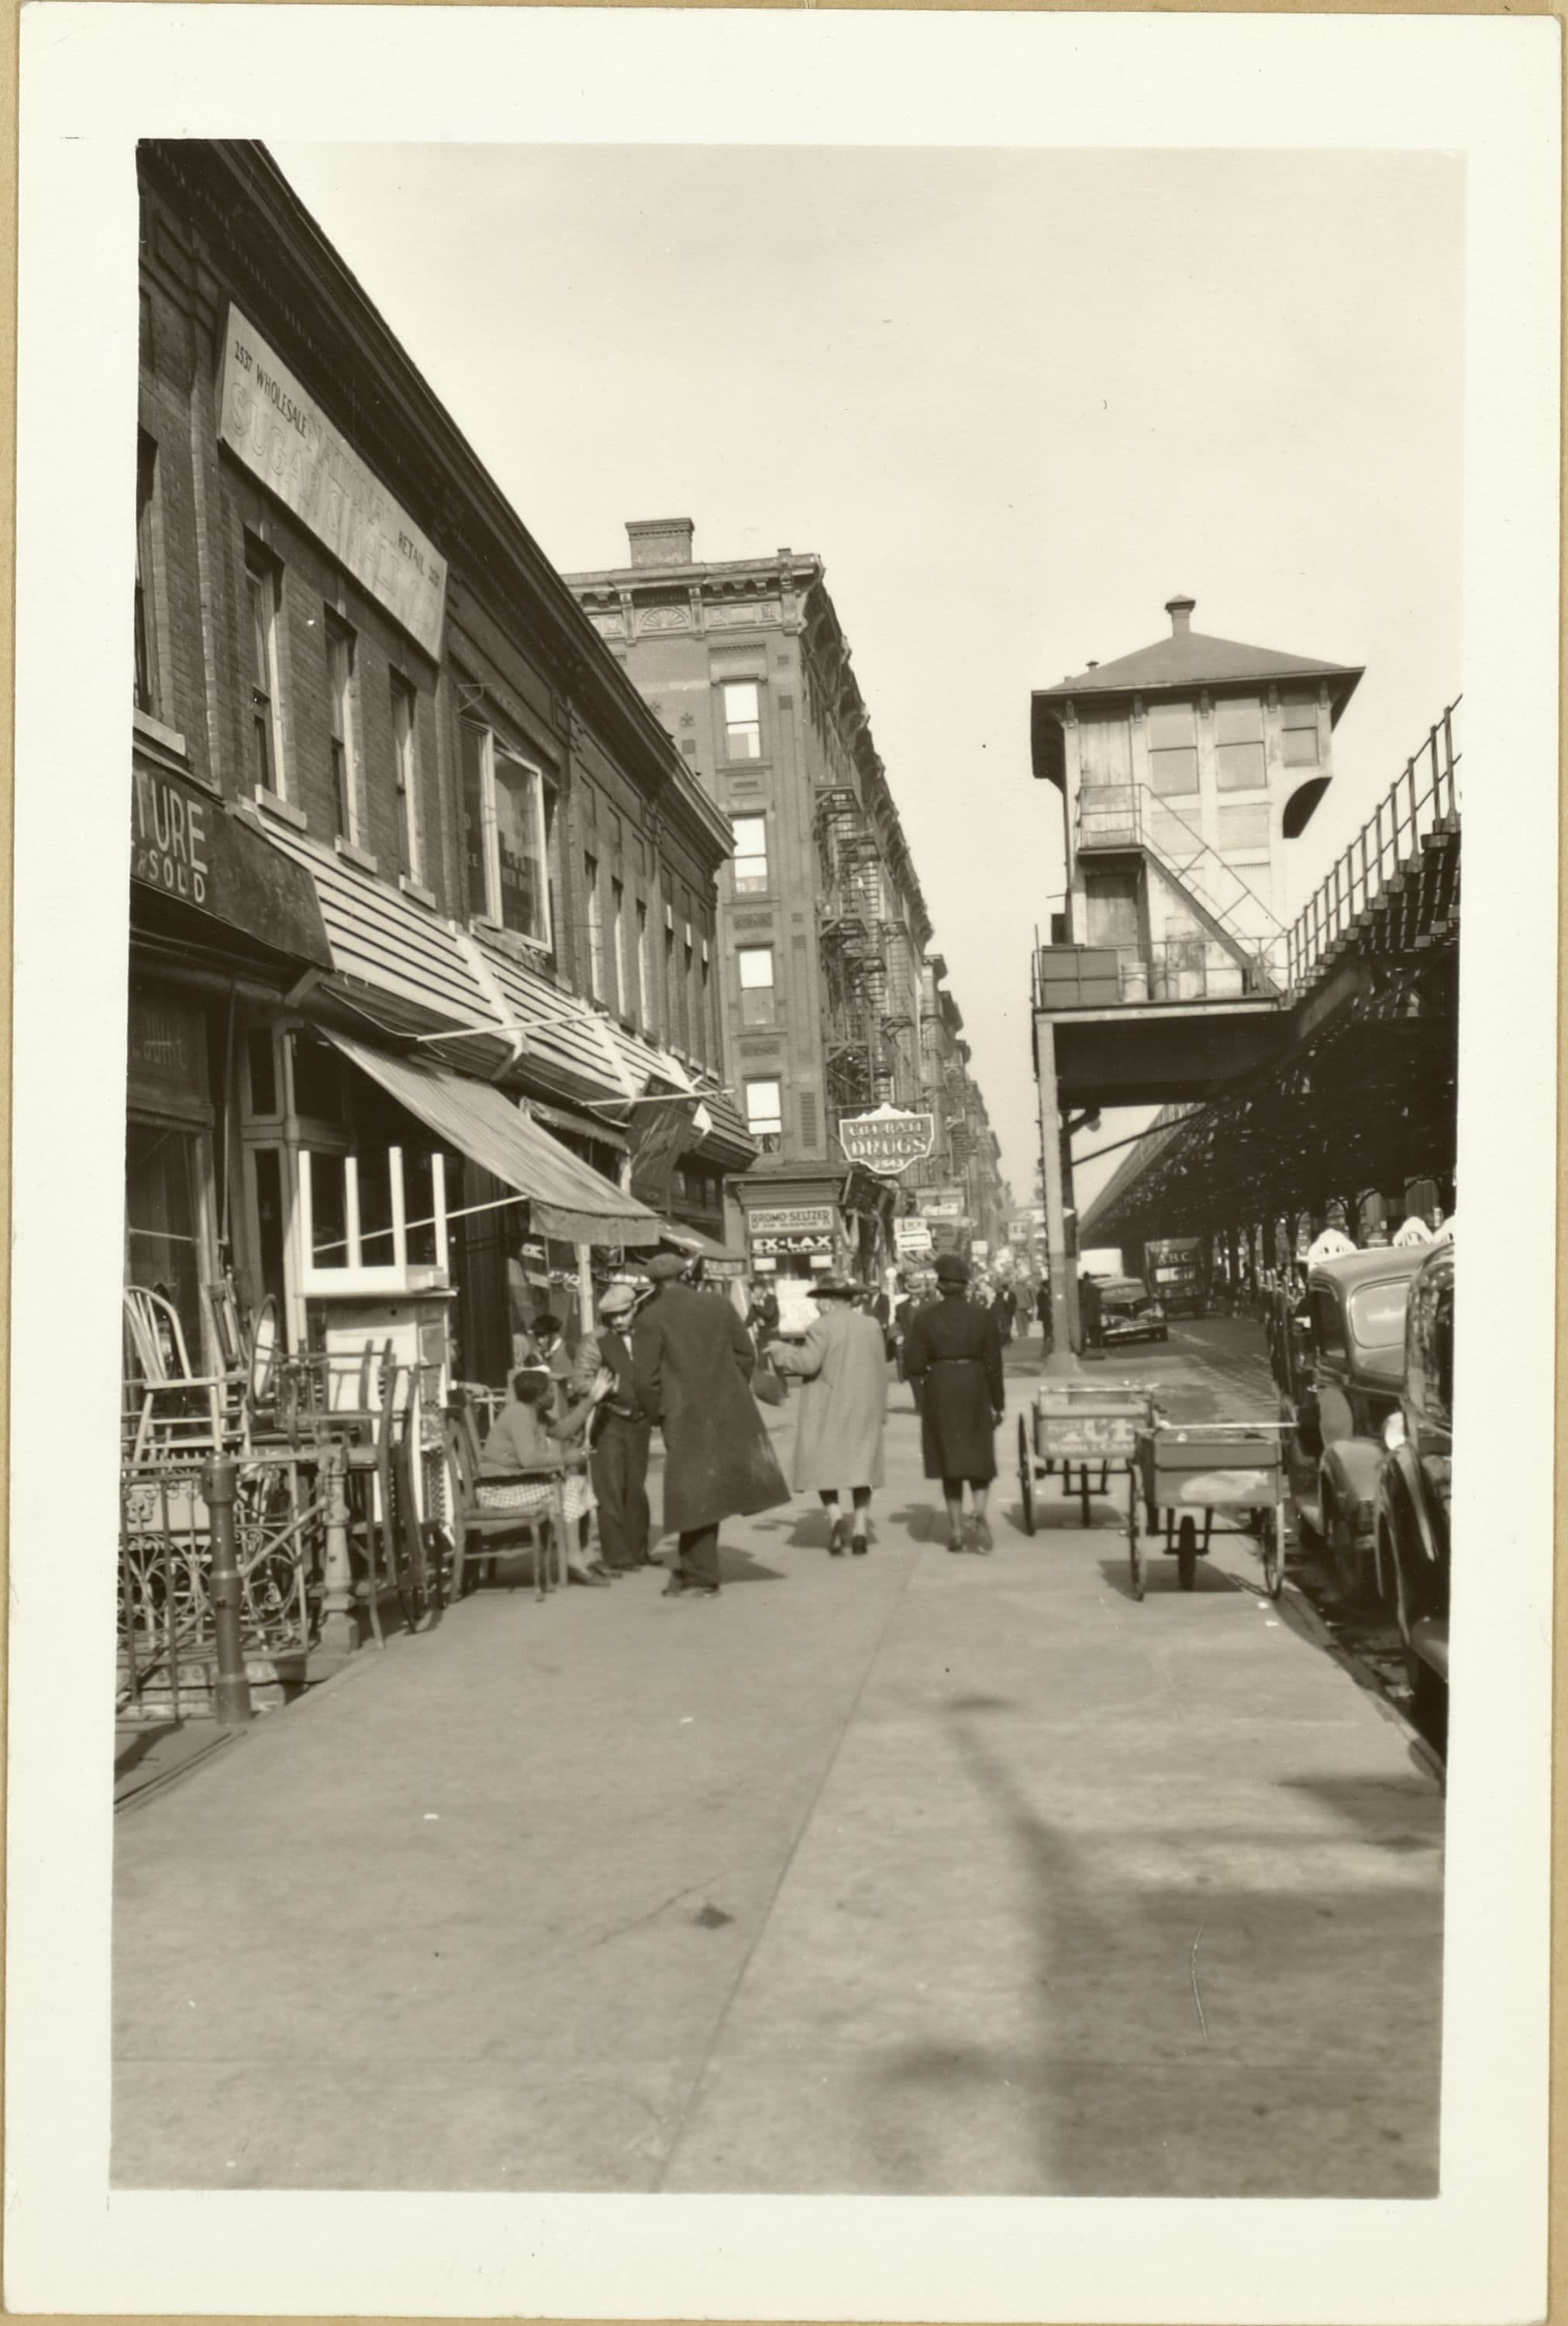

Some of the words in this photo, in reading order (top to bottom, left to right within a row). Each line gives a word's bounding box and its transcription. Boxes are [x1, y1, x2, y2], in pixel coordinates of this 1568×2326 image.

[234, 340, 253, 373] 2537
[256, 363, 307, 439] WHOLESALE
[398, 530, 426, 577] RETAIL
[148, 849, 205, 904] SOLD
[852, 1137, 926, 1156] DRUGS
[753, 1235, 832, 1251] EX-LAX
